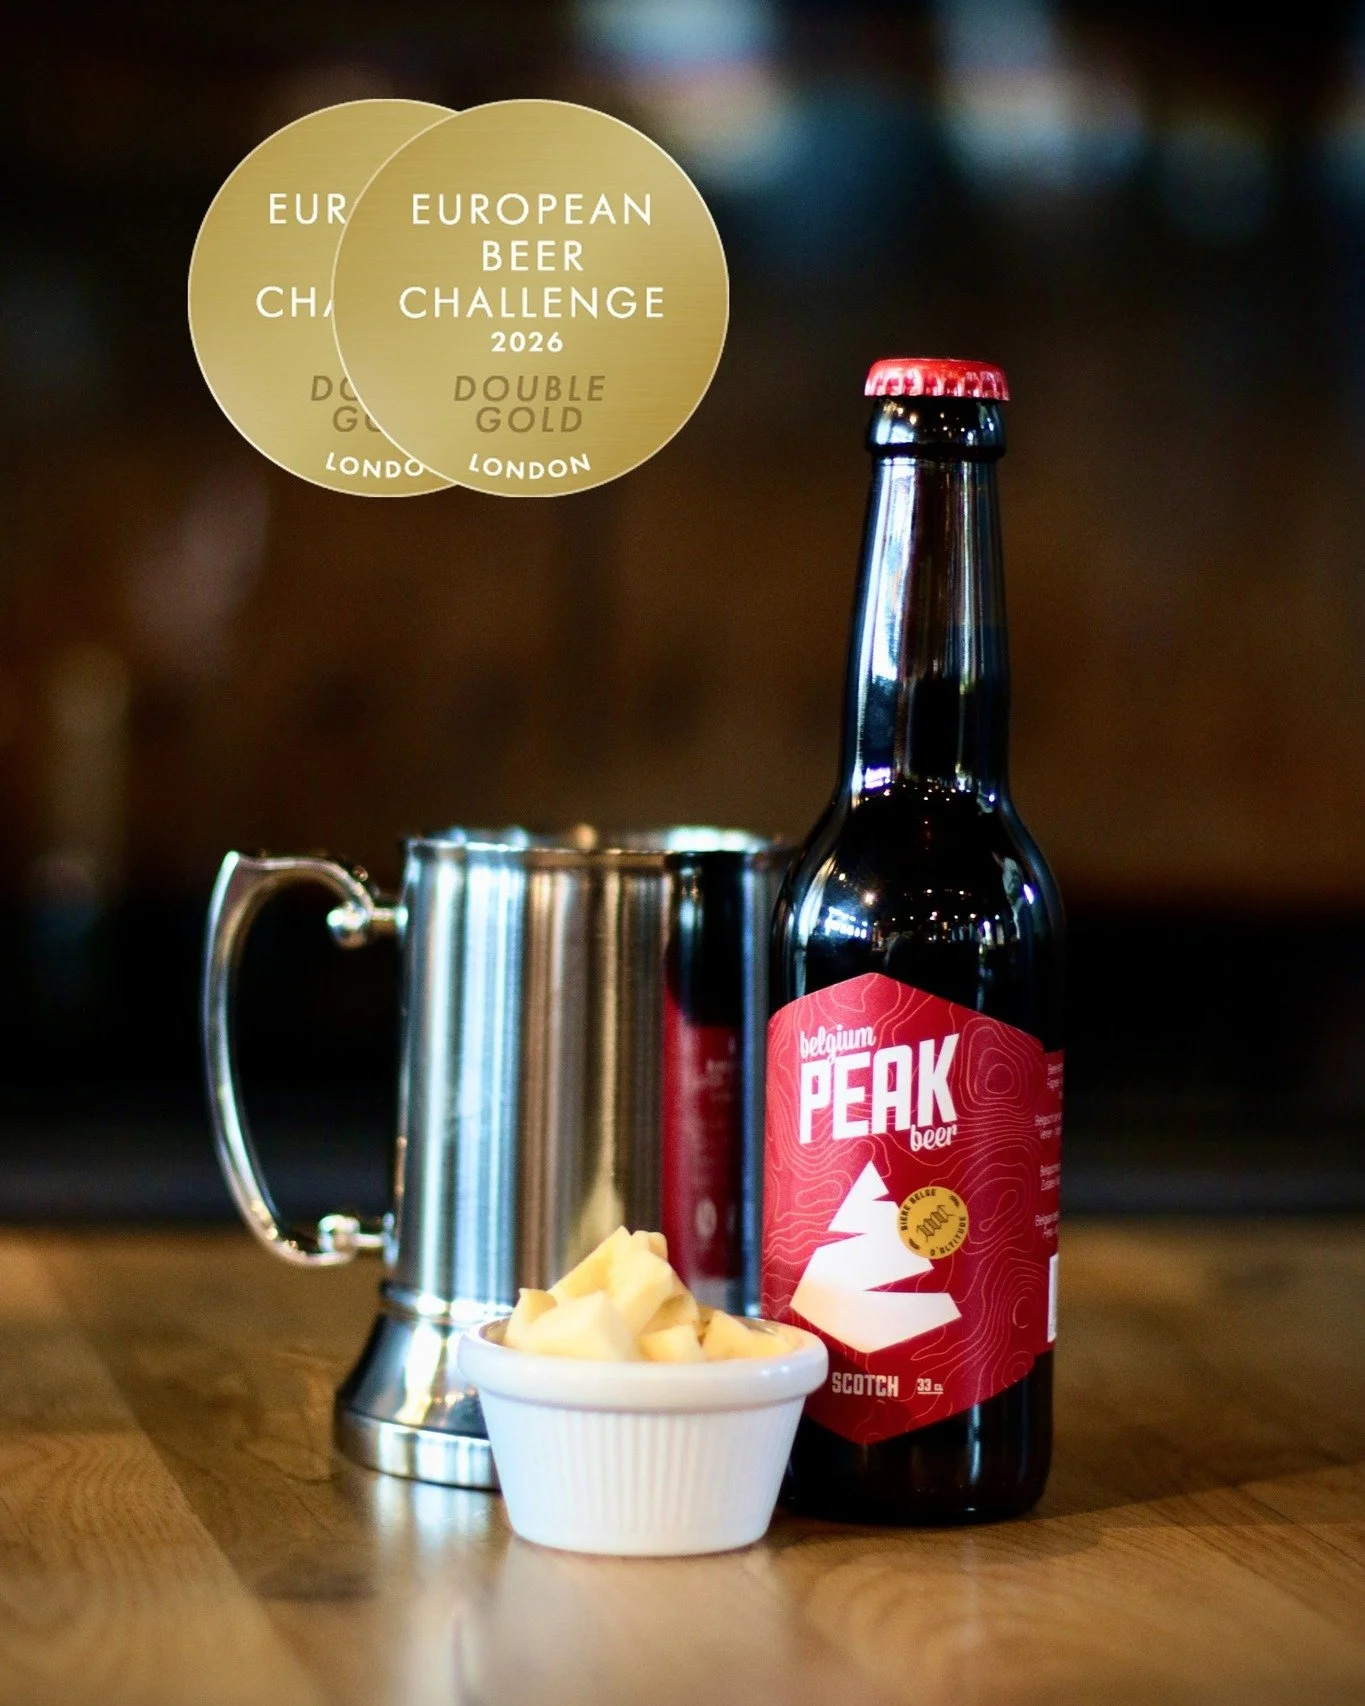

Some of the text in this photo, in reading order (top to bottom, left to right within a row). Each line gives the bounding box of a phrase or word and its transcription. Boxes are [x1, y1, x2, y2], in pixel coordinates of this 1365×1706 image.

[800, 1024, 876, 1064] belgium
[799, 1033, 960, 1145] PEAK
[910, 1124, 958, 1152] beer
[831, 1371, 899, 1397] SCOTCH
[917, 1378, 931, 1392] 33
